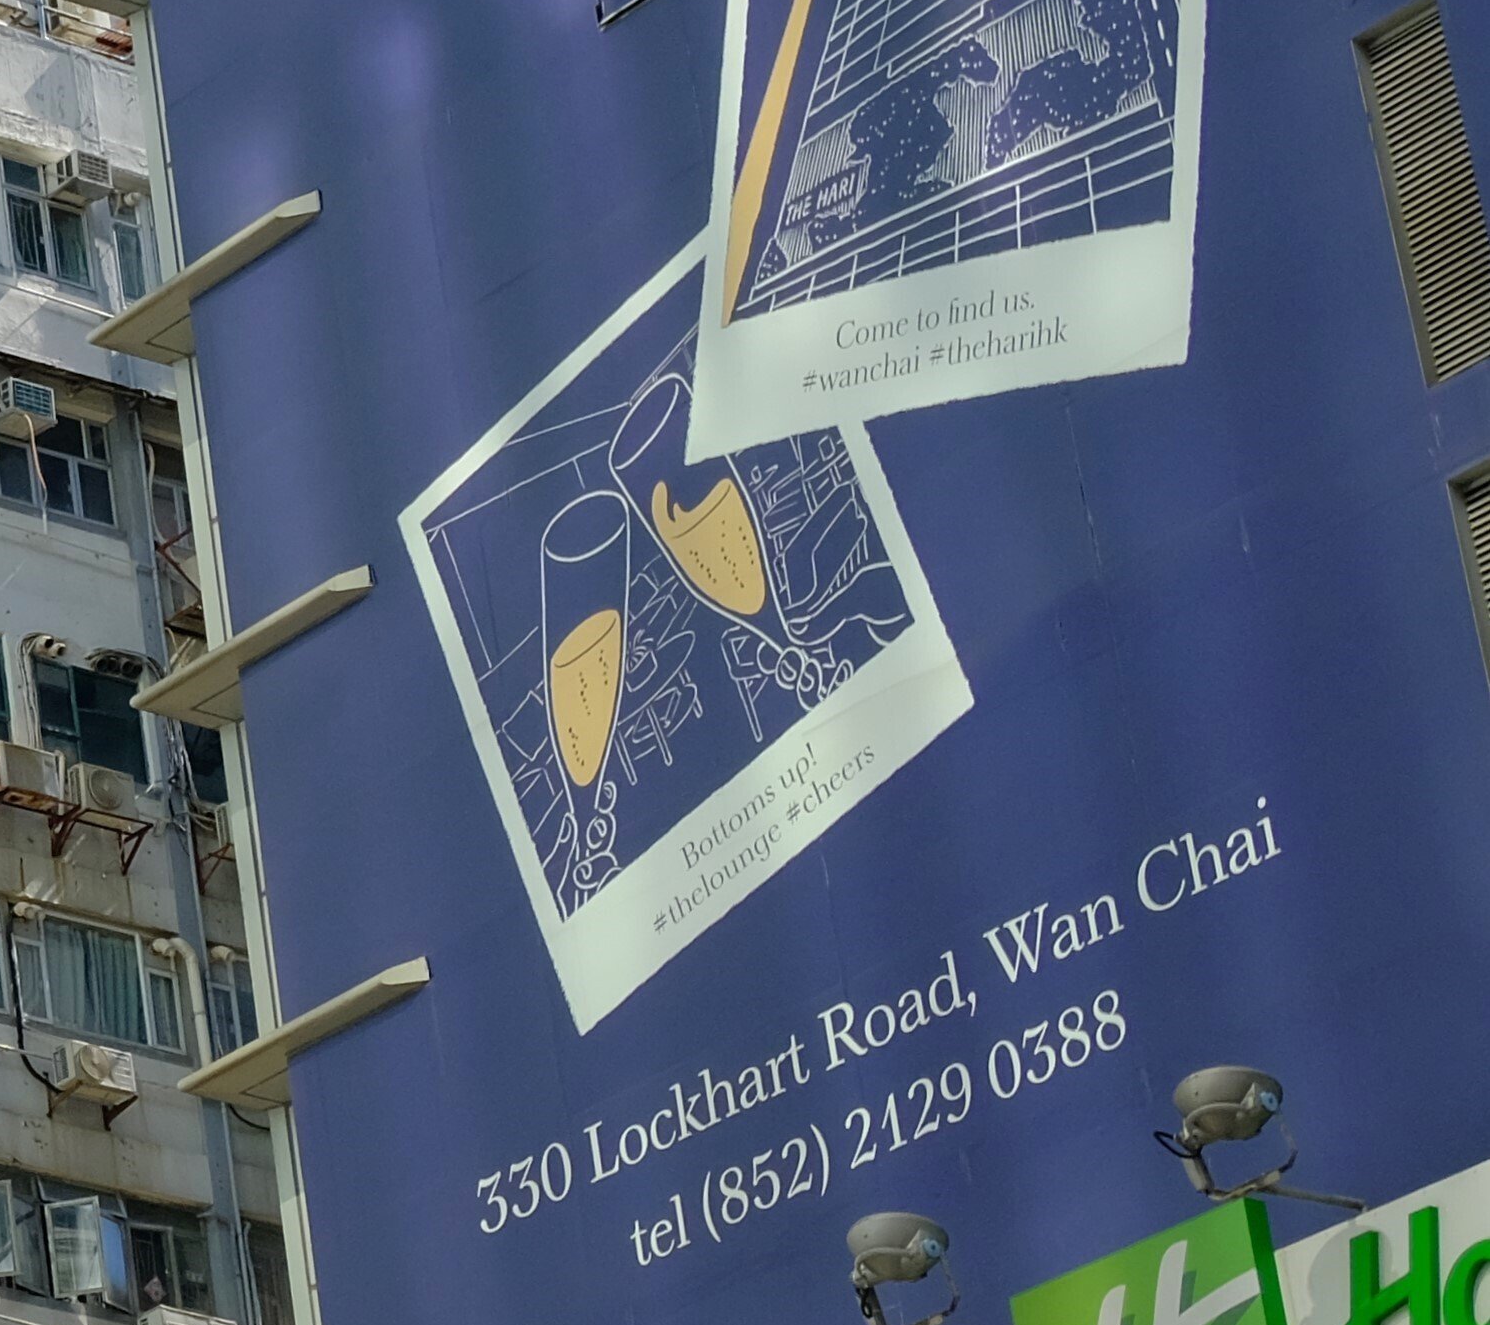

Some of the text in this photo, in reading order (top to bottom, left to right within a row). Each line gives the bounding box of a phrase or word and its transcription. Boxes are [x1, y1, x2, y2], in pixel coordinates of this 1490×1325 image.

[785, 173, 856, 226] THE HARI
[802, 316, 1068, 393] #wanchai #theharihk
[836, 290, 1035, 349] Come to find us.
[652, 745, 876, 935] #thelounge #cheers
[680, 741, 818, 870] Bottoms up!
[476, 796, 1282, 1234] 330 Lockhart Road, Wan Chai
[630, 989, 1127, 1266] tel (852) 2129 0388
